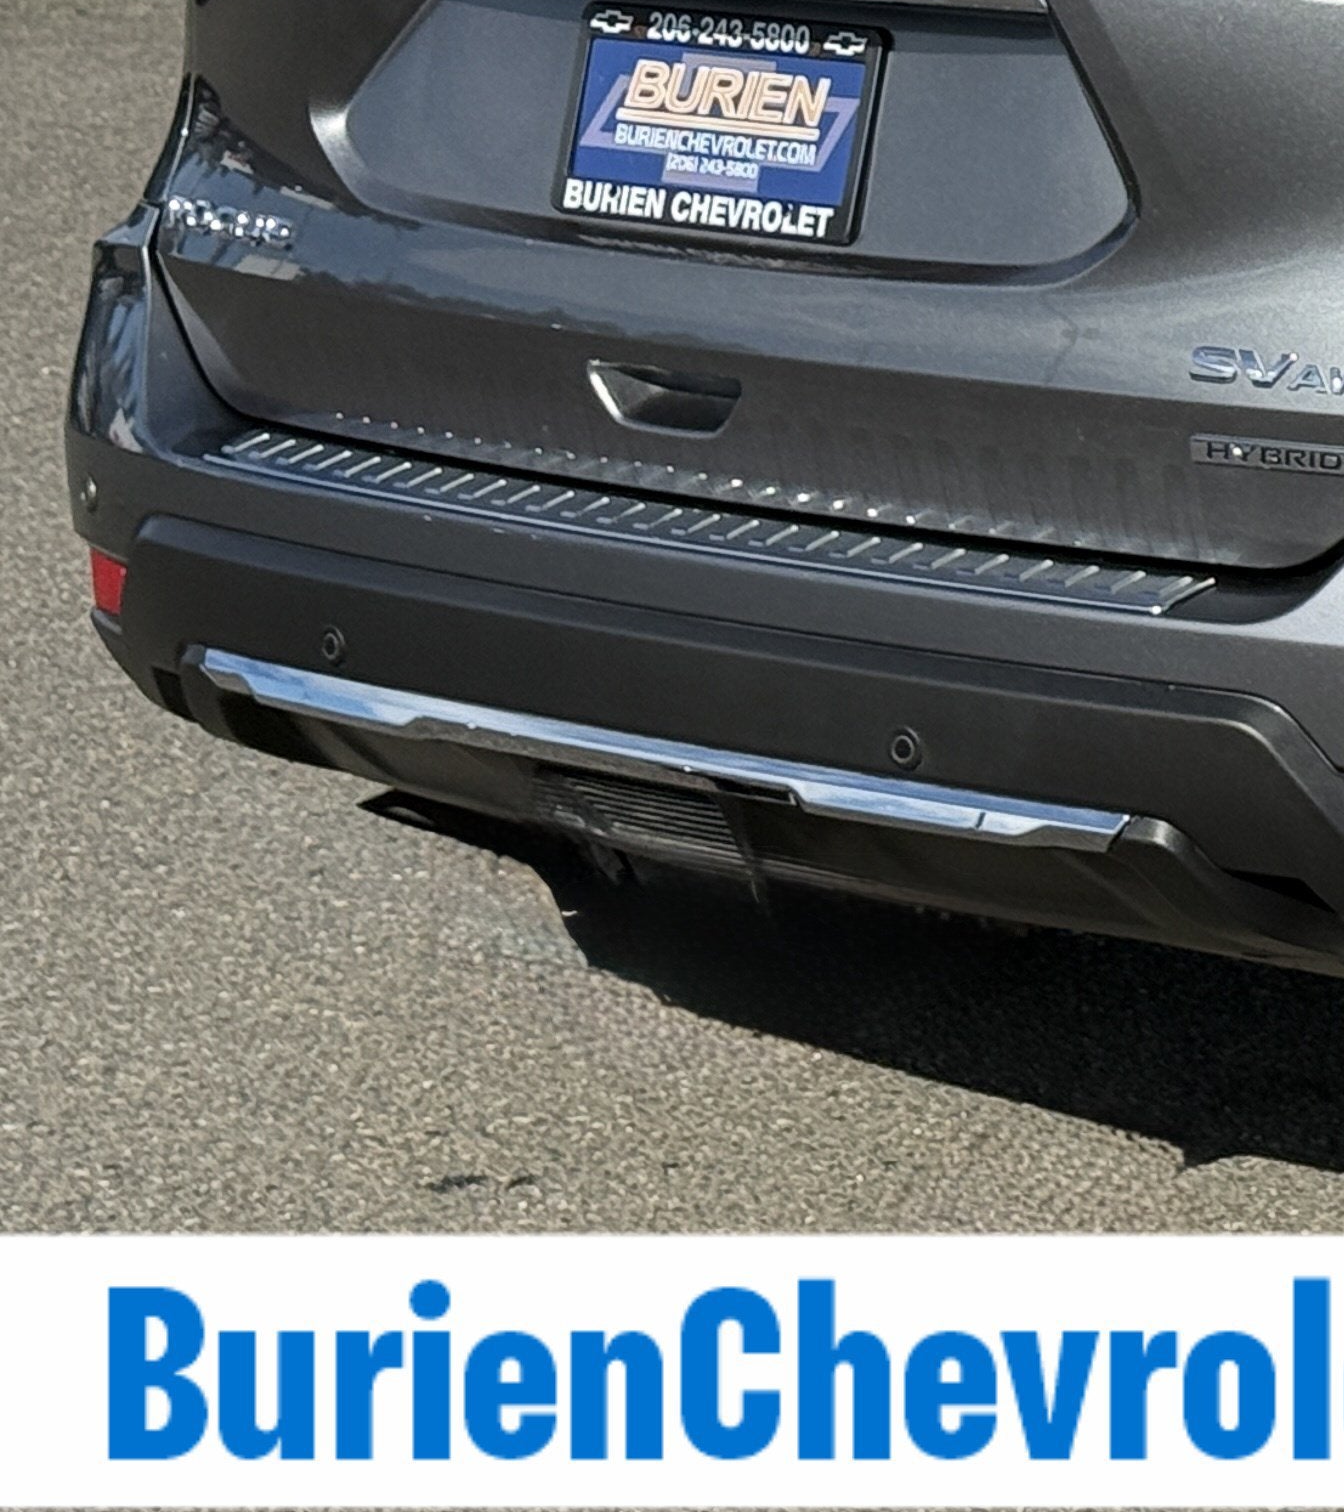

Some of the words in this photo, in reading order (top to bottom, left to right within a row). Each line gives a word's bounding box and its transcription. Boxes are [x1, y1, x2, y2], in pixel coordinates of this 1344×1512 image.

[623, 58, 832, 127] BURIEN
[613, 124, 817, 166] BURIENCHEVROLET.COM
[563, 178, 666, 219] BURIEN
[670, 190, 834, 238] CHEVROLET
[1206, 441, 1342, 471] HYBRID
